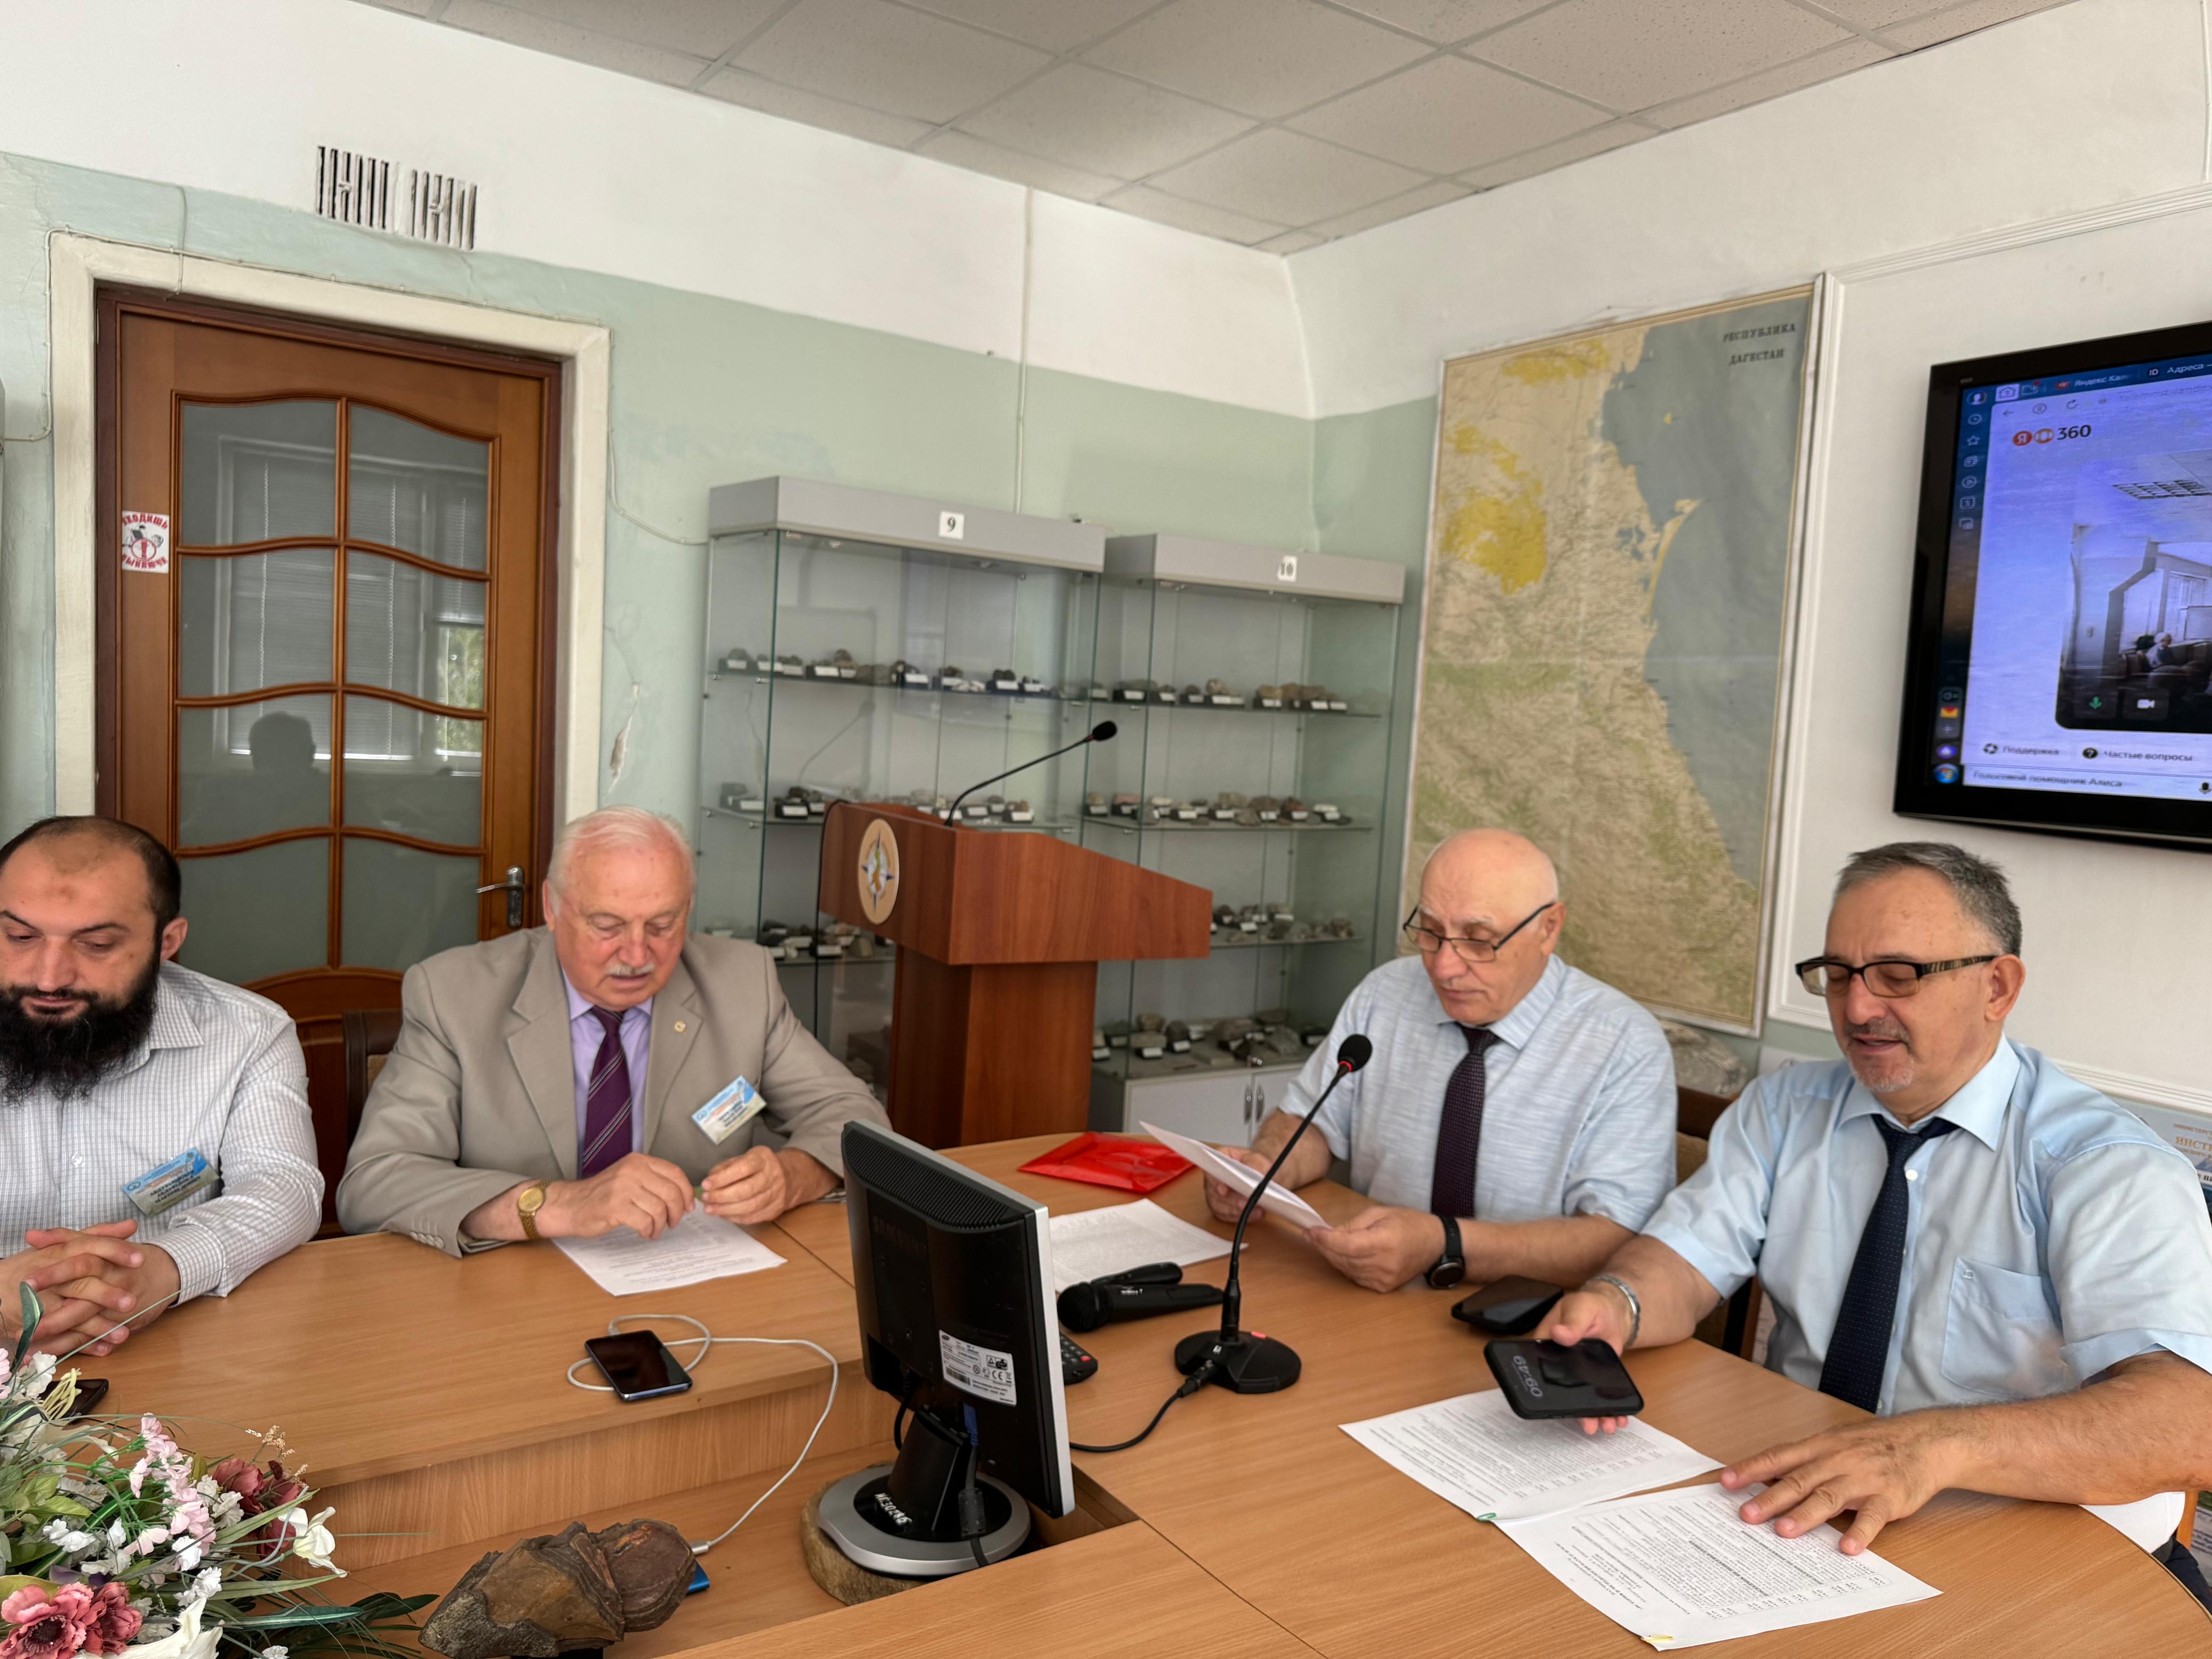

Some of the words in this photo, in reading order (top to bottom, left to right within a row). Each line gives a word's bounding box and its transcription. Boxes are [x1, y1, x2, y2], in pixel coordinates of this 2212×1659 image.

[1723, 323, 1796, 342] РЕСПУБЛИКА
[1729, 348, 1785, 366] ДАГЕСТАН
[2167, 363, 2205, 374] Адреса
[2074, 377, 2107, 387] Яндекс
[2057, 425, 2091, 440] 360
[947, 516, 956, 532] 9
[2003, 745, 2059, 756] Поддержка
[2104, 750, 2143, 760] Частые
[2144, 752, 2193, 762] вопросы
[1973, 770, 2026, 781] Голосовой
[2029, 774, 2085, 785] помощник
[2089, 777, 2122, 788] Алиса
